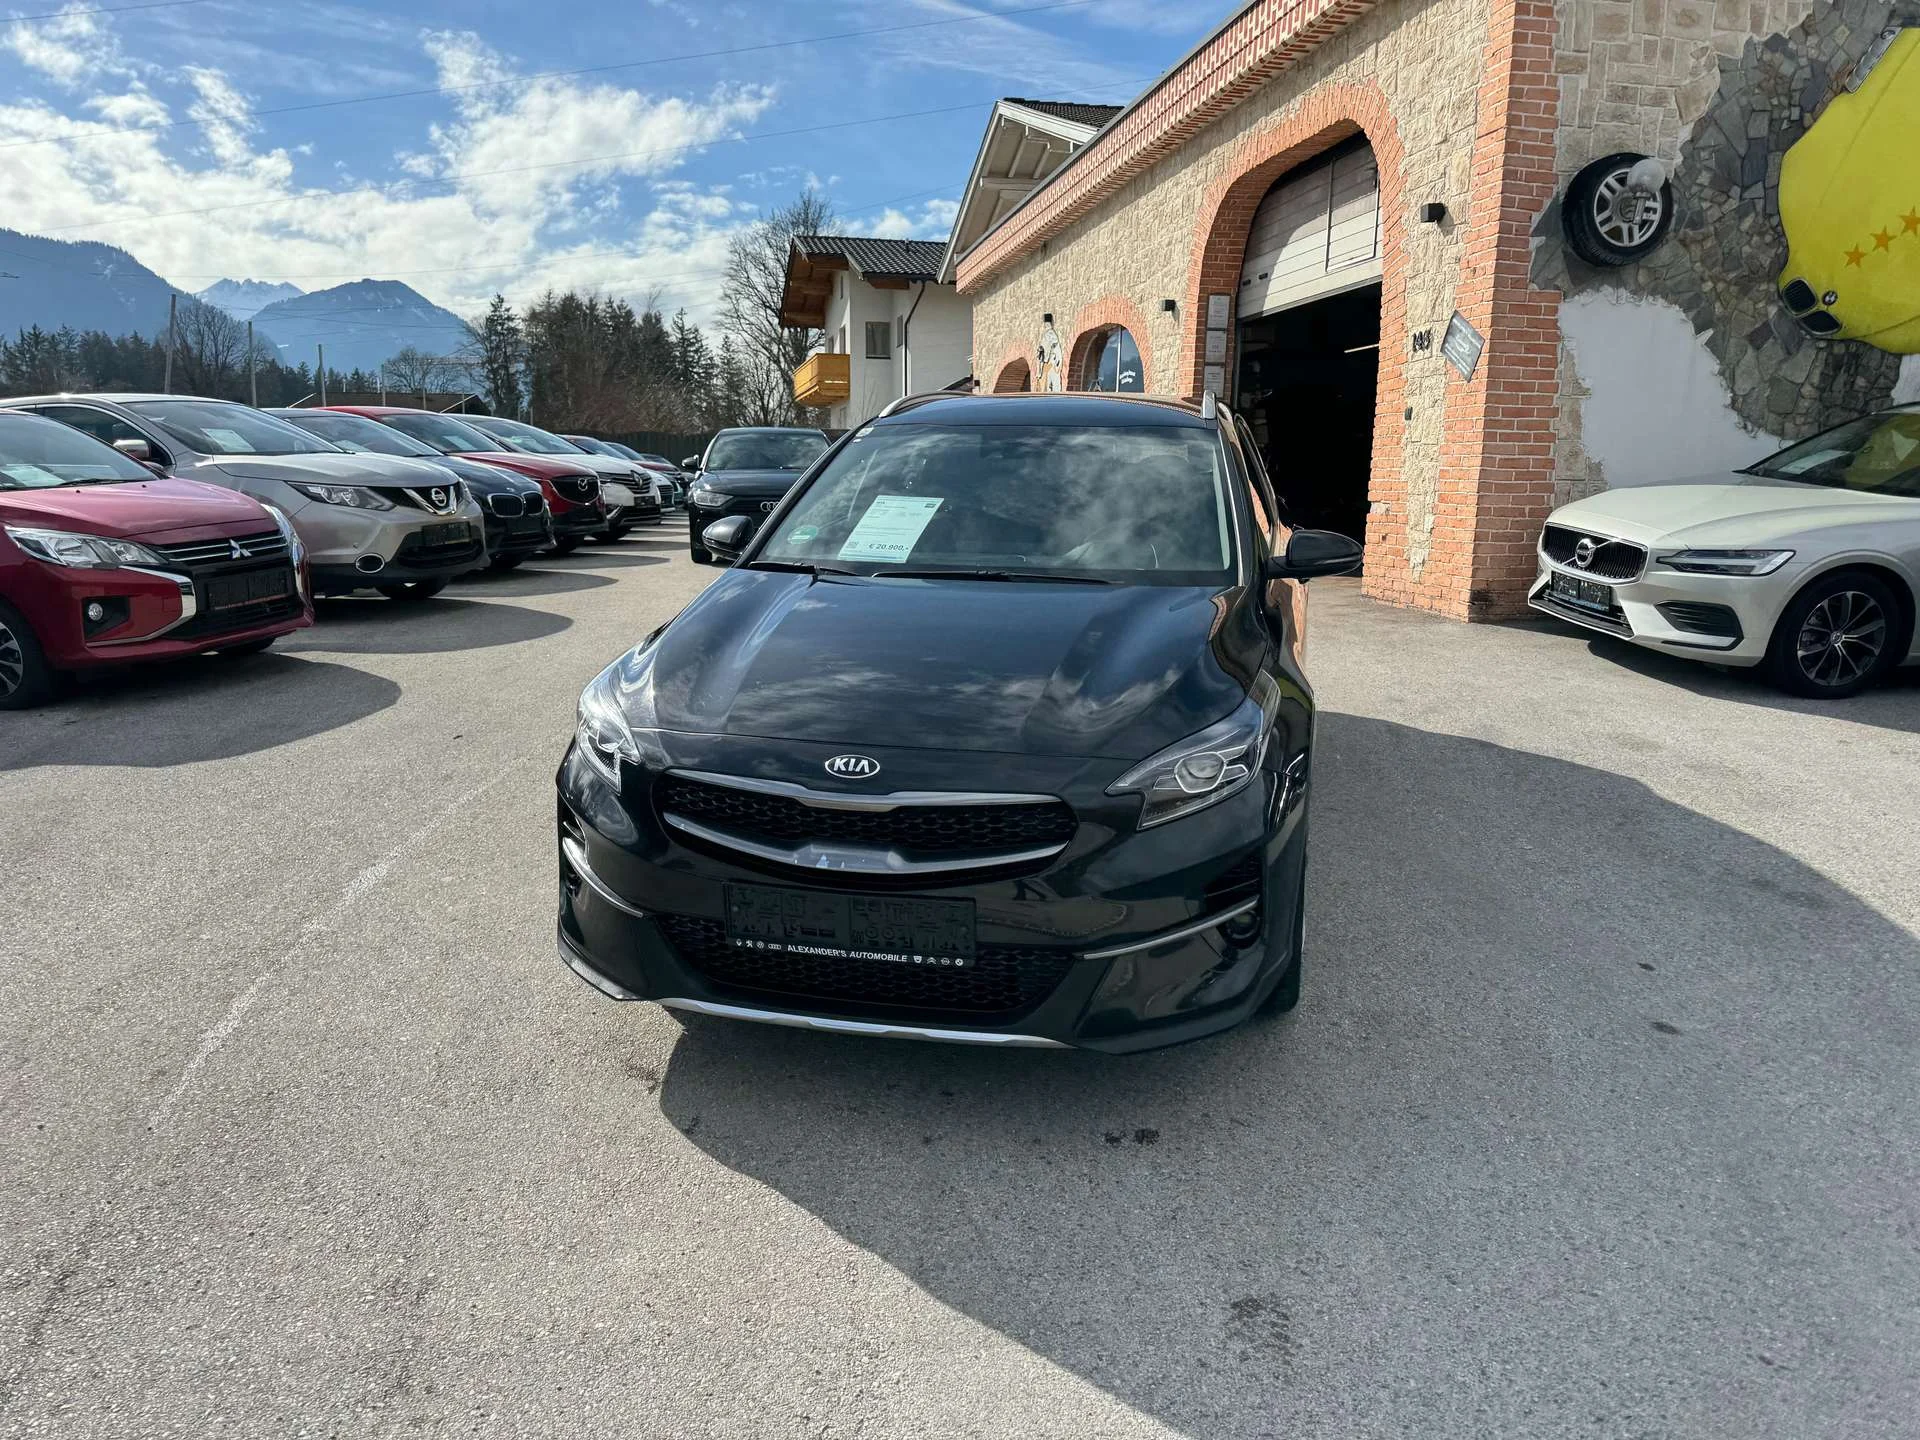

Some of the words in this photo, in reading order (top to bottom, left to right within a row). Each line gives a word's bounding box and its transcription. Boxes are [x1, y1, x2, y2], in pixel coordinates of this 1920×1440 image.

[833, 757, 870, 774] KIA
[787, 944, 847, 957] ALEXANDER'S
[849, 951, 908, 962] AUTOMOBILE
